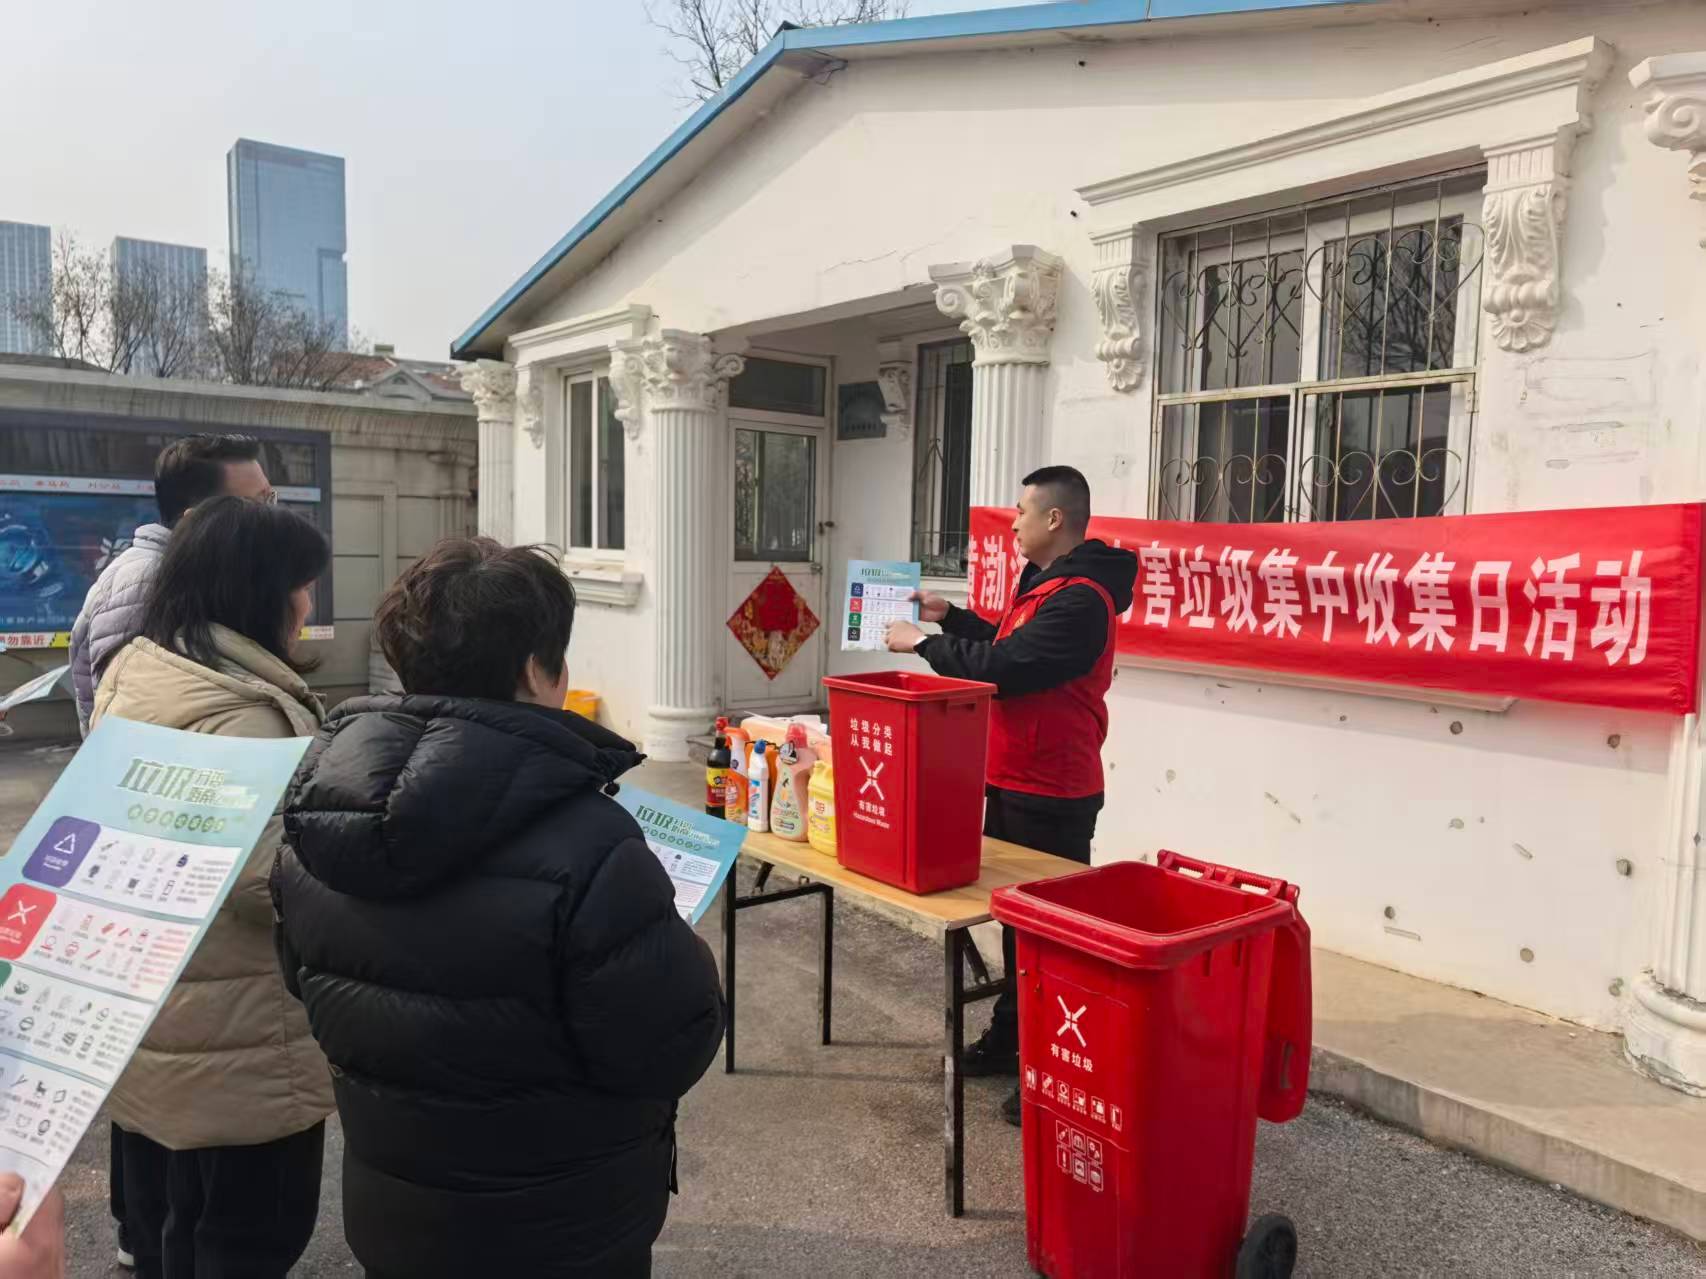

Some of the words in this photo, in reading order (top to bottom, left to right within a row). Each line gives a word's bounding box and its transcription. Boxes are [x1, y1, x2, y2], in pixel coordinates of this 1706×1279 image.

[1113, 538, 1652, 665] 害垃圾集中收集日活动
[1050, 1043, 1093, 1073] 有害垃圾
